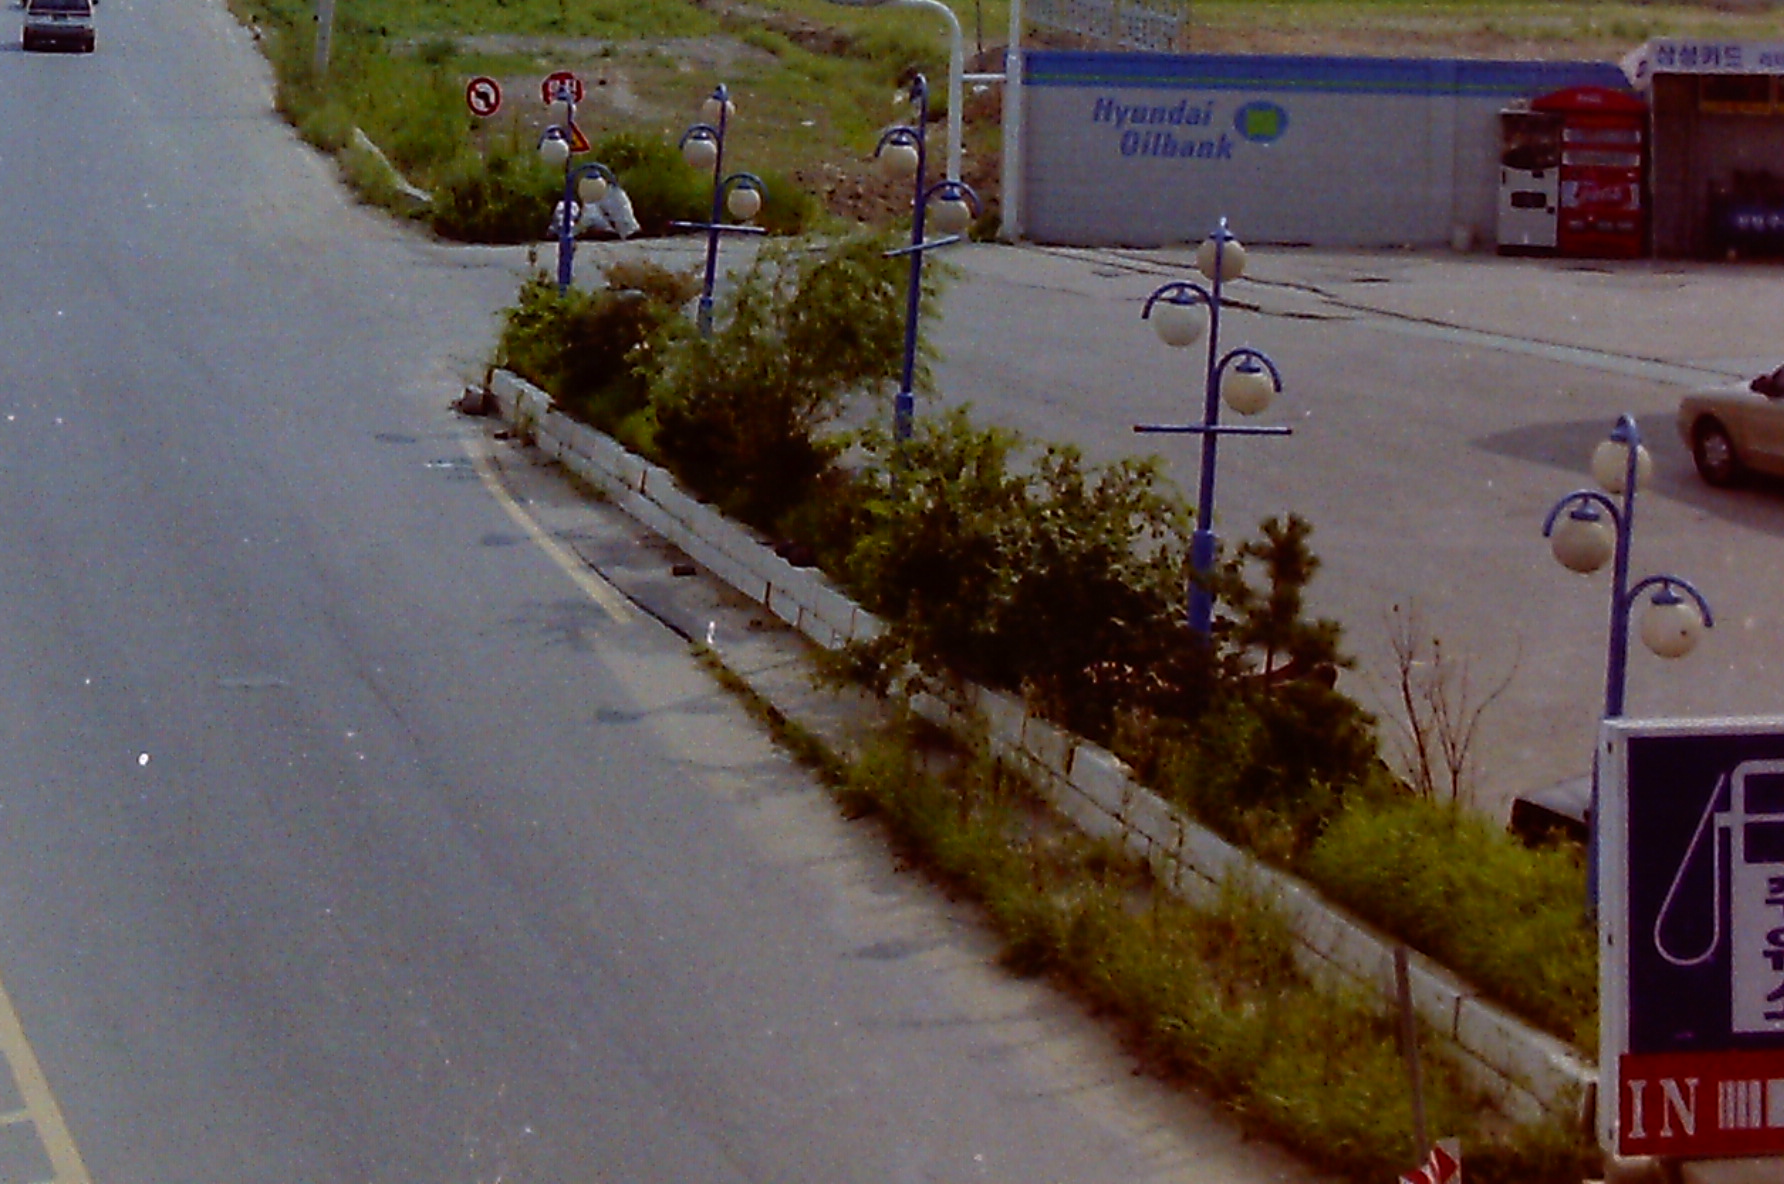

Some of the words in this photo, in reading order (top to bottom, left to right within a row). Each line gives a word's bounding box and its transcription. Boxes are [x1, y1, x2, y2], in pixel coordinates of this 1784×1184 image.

[1657, 45, 1742, 67] 삼성카드
[1093, 97, 1214, 129] Hyundai
[1120, 129, 1232, 159] Oilbank
[1627, 1077, 1699, 1139] IN
